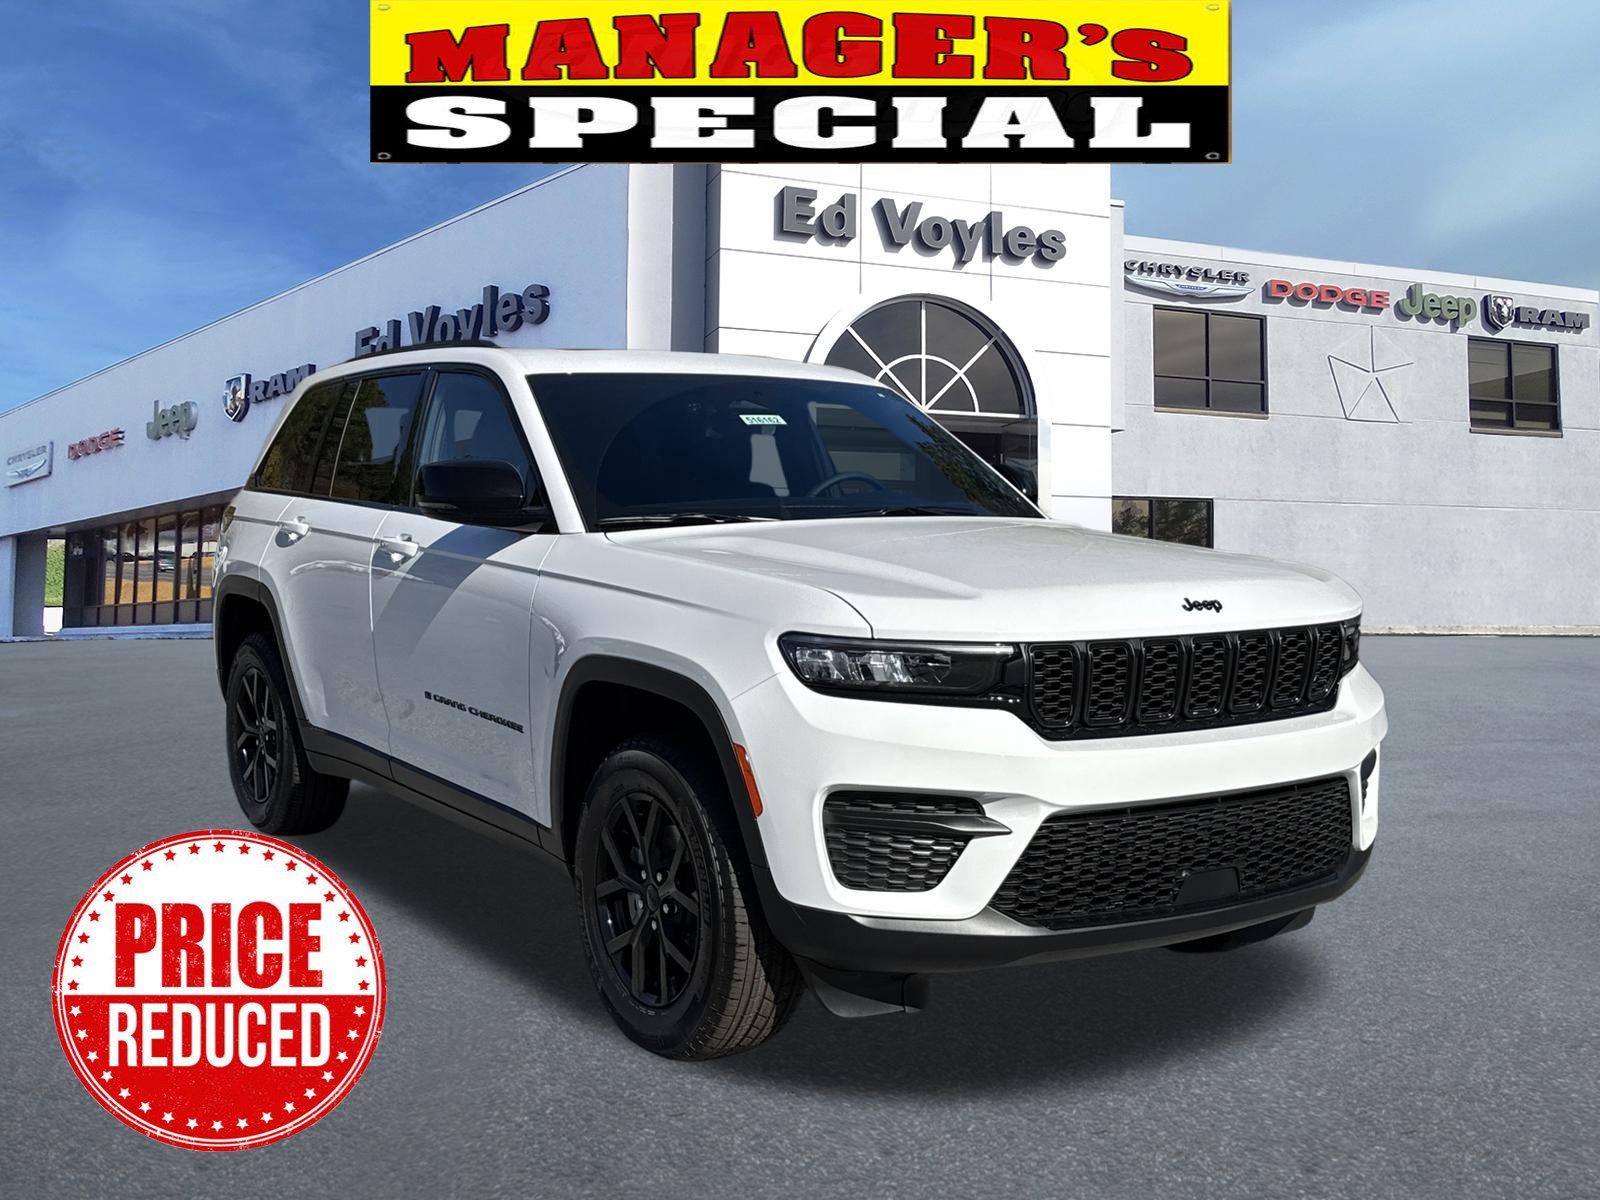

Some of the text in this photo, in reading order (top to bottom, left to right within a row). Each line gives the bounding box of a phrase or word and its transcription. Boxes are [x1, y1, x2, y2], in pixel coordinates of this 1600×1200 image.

[774, 186, 1066, 268] Ed Voyles
[1124, 259, 1250, 285] CHRYSLER
[1263, 279, 1390, 314] DODGE
[1395, 282, 1477, 332] Jeep
[355, 284, 550, 357] Ed Voyles
[1512, 306, 1590, 333] RAM
[250, 363, 316, 403] RAM
[147, 399, 198, 441] Jeep
[67, 427, 125, 460] DODGE
[1182, 597, 1222, 614] Jeep
